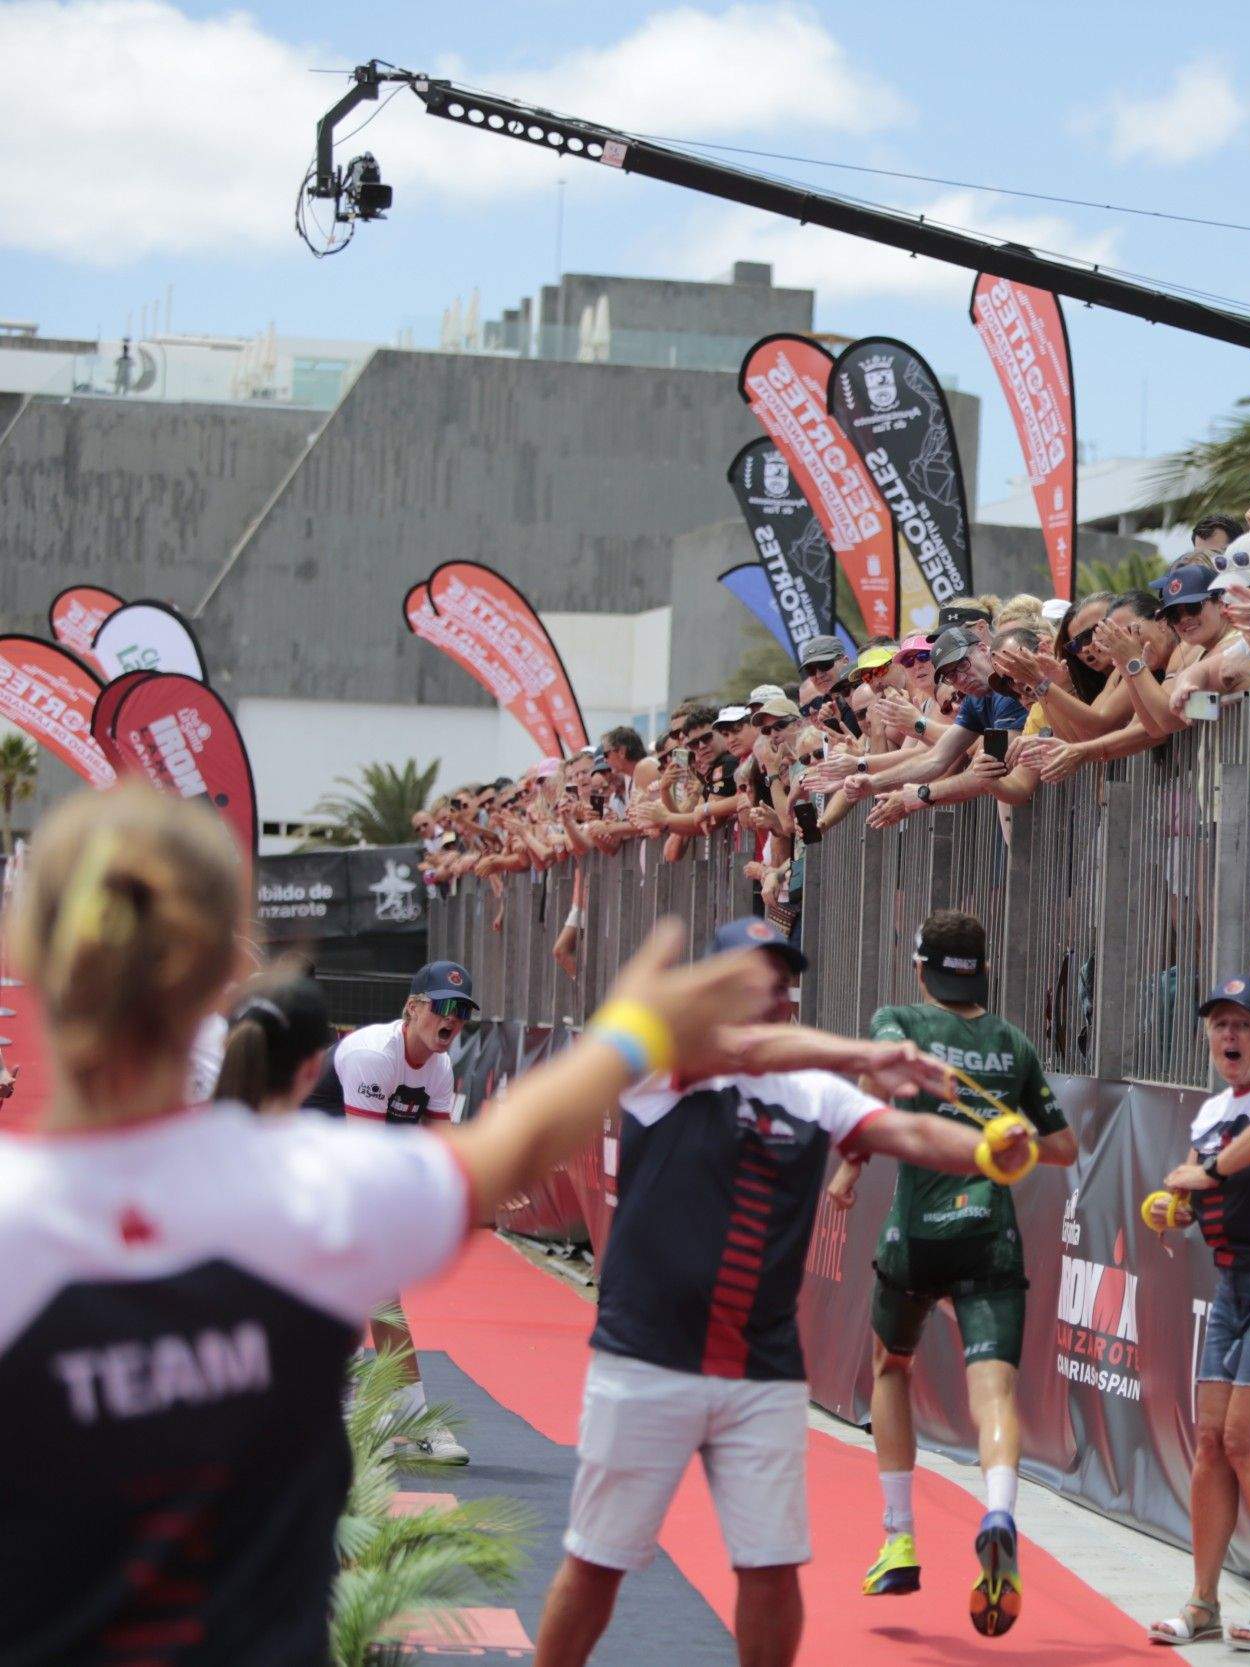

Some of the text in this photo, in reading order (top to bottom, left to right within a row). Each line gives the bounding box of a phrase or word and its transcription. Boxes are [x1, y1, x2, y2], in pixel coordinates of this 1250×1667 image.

[149, 714, 208, 798] IRON
[257, 881, 334, 902] bildo de
[257, 902, 328, 918] nzarote
[51, 1320, 274, 1425] TEAM
[1098, 1370, 1141, 1402] SPAIN
